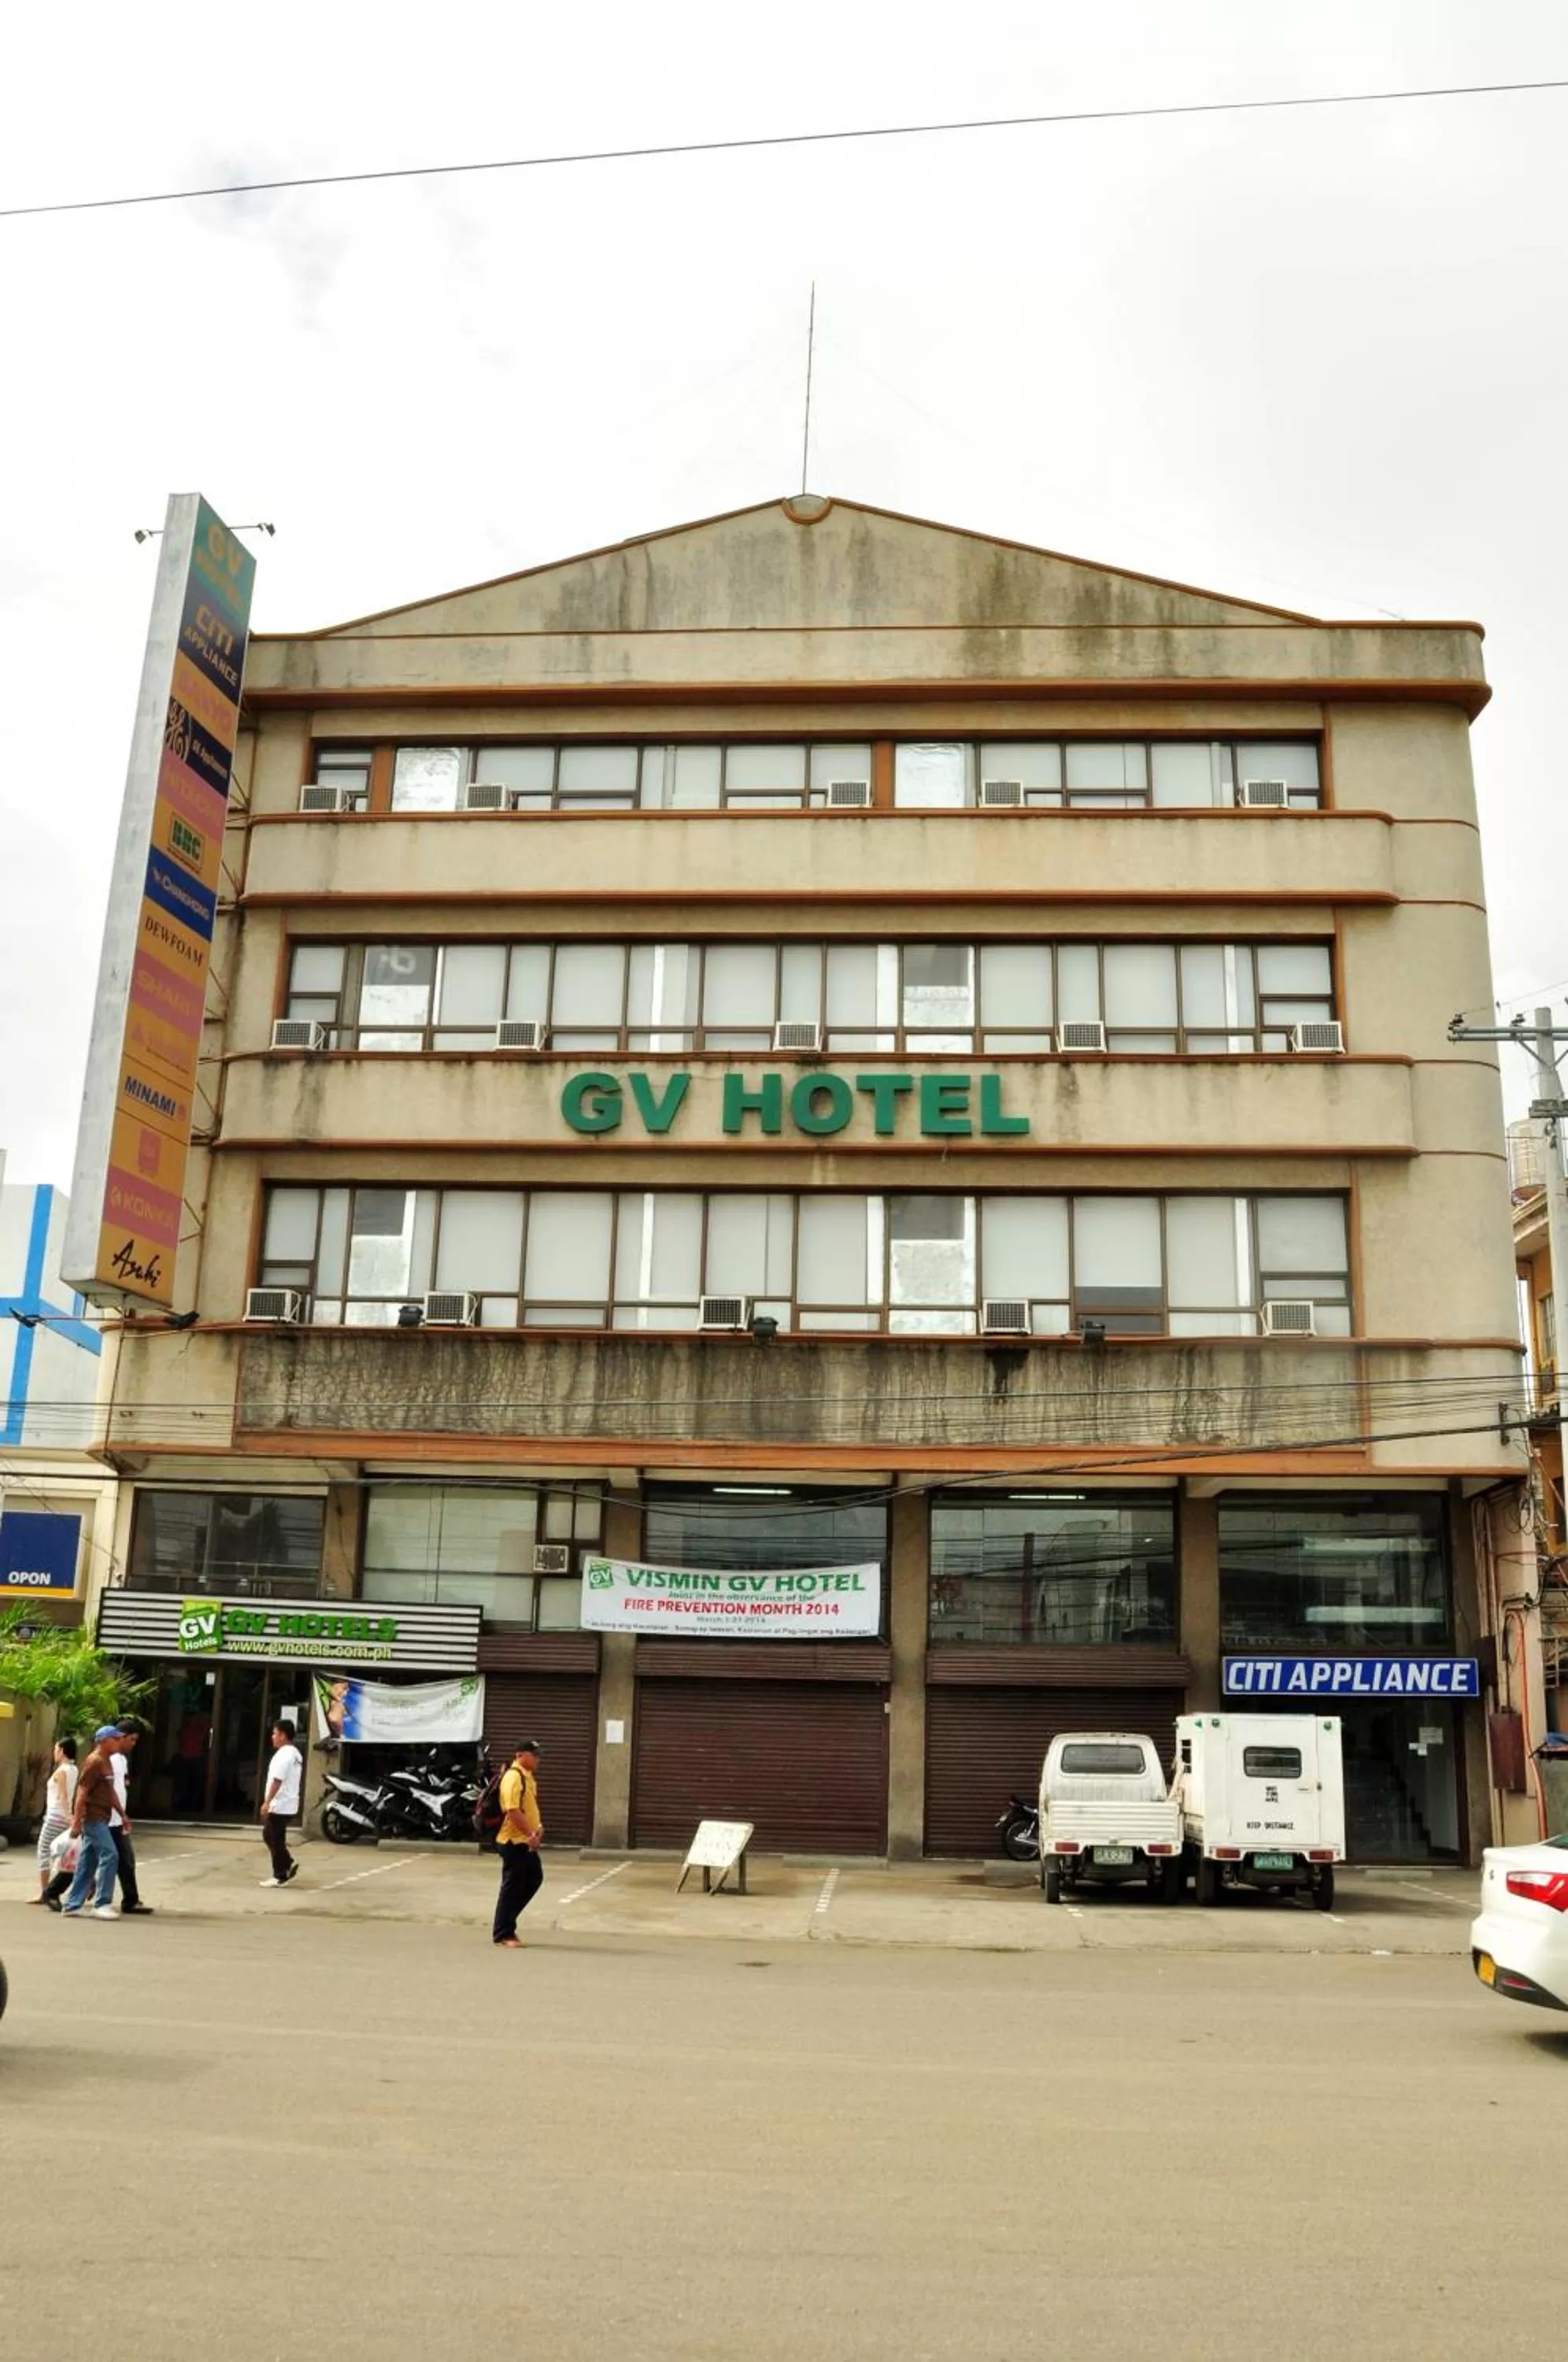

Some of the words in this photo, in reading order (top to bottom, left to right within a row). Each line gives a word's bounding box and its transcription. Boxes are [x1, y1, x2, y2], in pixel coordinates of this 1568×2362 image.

[195, 604, 233, 657] CITI
[183, 626, 239, 687] APPLIANCE
[145, 916, 203, 968] DEWFOAM
[125, 1075, 176, 1118] MINAMI
[561, 1072, 691, 1133] GV
[722, 1073, 1030, 1135] HOTEL
[8, 1571, 51, 1585] OPON
[627, 1568, 720, 1590] VISMIN
[729, 1575, 768, 1591] GV
[775, 1574, 866, 1591] HOTEL
[624, 1599, 654, 1611] FIRE
[657, 1601, 746, 1615] PREVENTION
[750, 1604, 802, 1616] MONTH
[806, 1603, 839, 1615] 2014
[179, 1614, 216, 1638] GV
[227, 1609, 268, 1635] GV
[279, 1613, 397, 1642] HOTELS
[184, 1638, 217, 1651] Hotels
[1227, 1661, 1281, 1692] CITI
[1287, 1661, 1472, 1692] APPLIANCE
